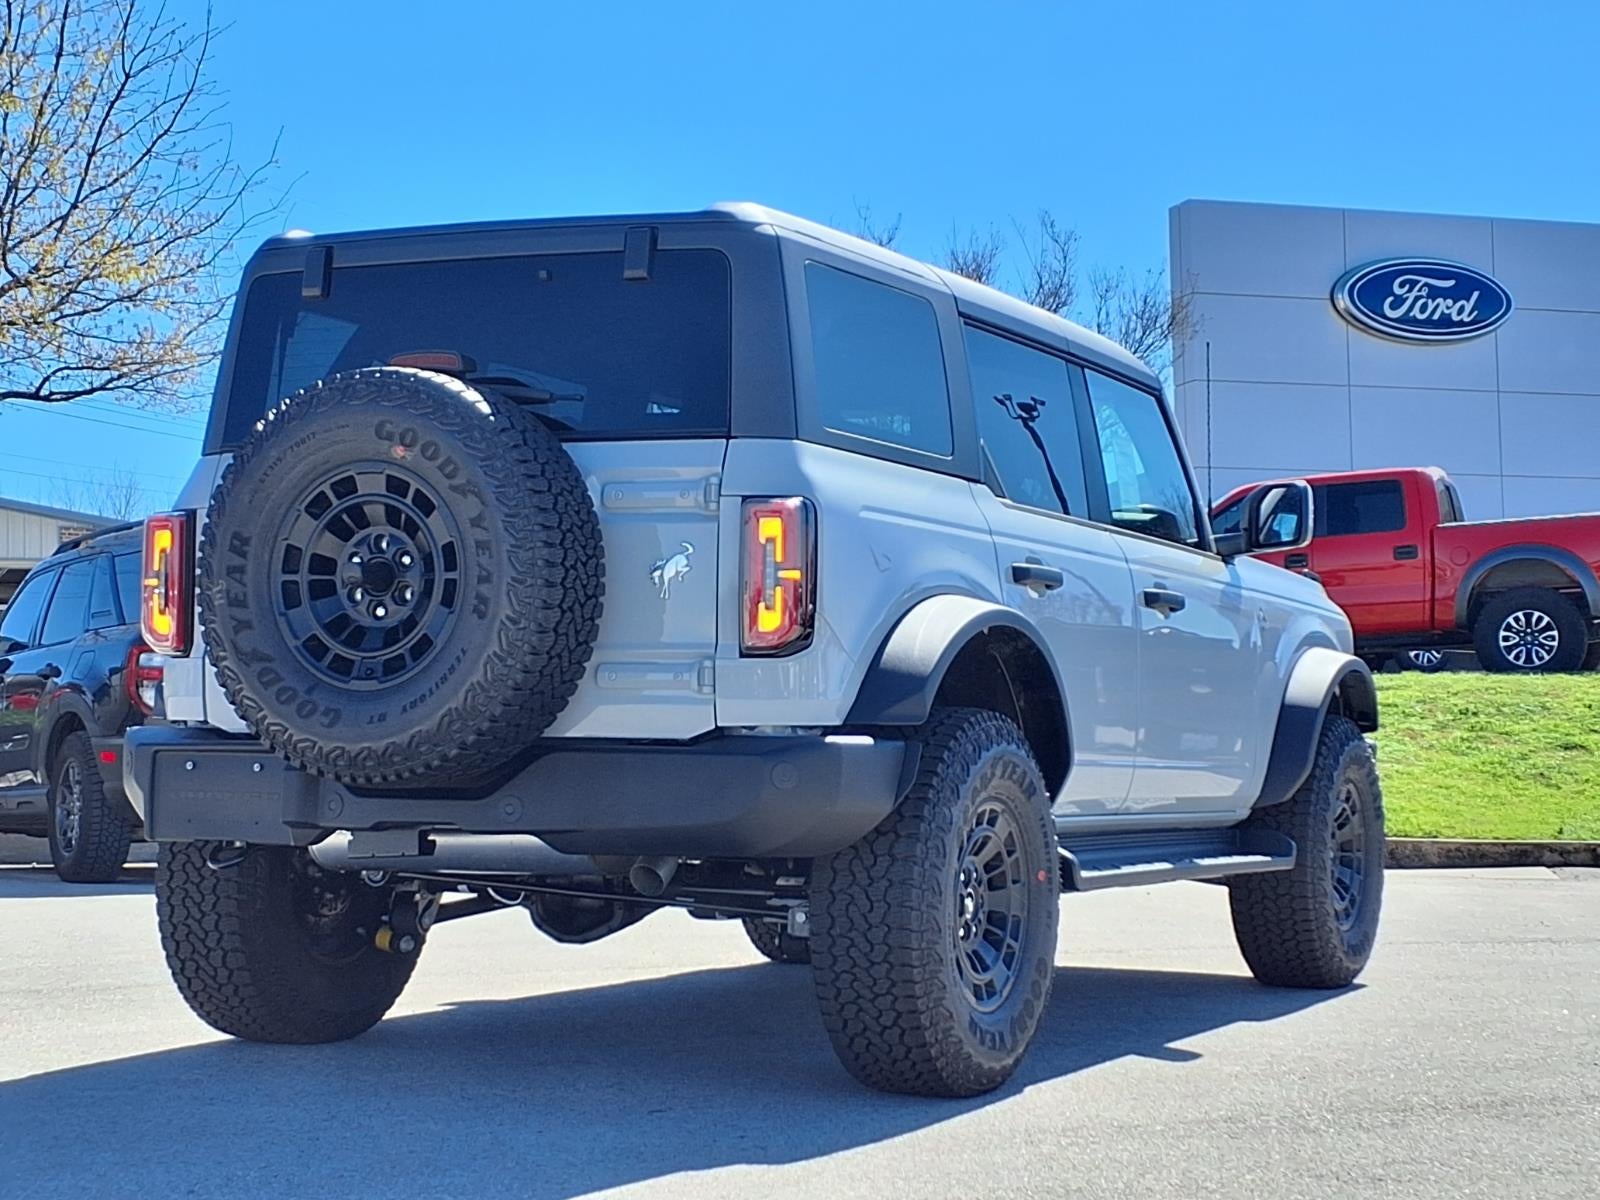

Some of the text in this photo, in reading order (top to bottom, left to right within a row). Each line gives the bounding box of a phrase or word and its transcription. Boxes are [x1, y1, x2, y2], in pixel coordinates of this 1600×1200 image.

[1383, 274, 1480, 322] Ford
[374, 419, 495, 621] GOODYEAR
[224, 529, 343, 729] GOODYEAR
